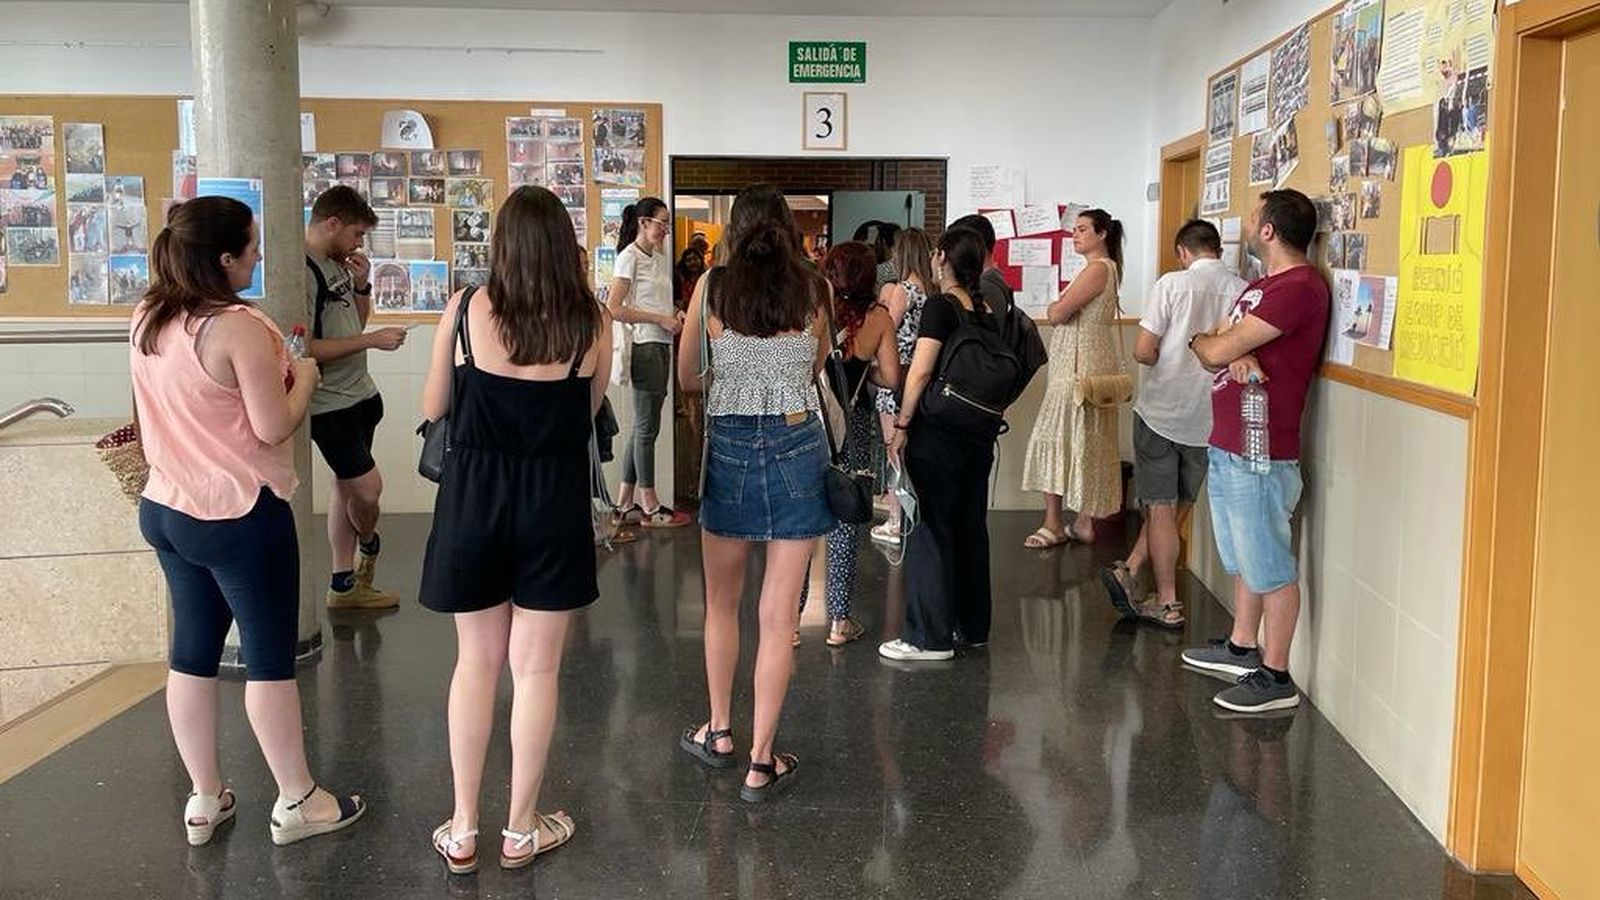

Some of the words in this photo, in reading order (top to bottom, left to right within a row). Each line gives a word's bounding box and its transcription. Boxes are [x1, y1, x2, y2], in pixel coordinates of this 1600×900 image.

[797, 47, 837, 61] SALIDA
[843, 47, 857, 61] DE
[793, 63, 862, 78] EMERGENCIA
[815, 107, 833, 139] 3
